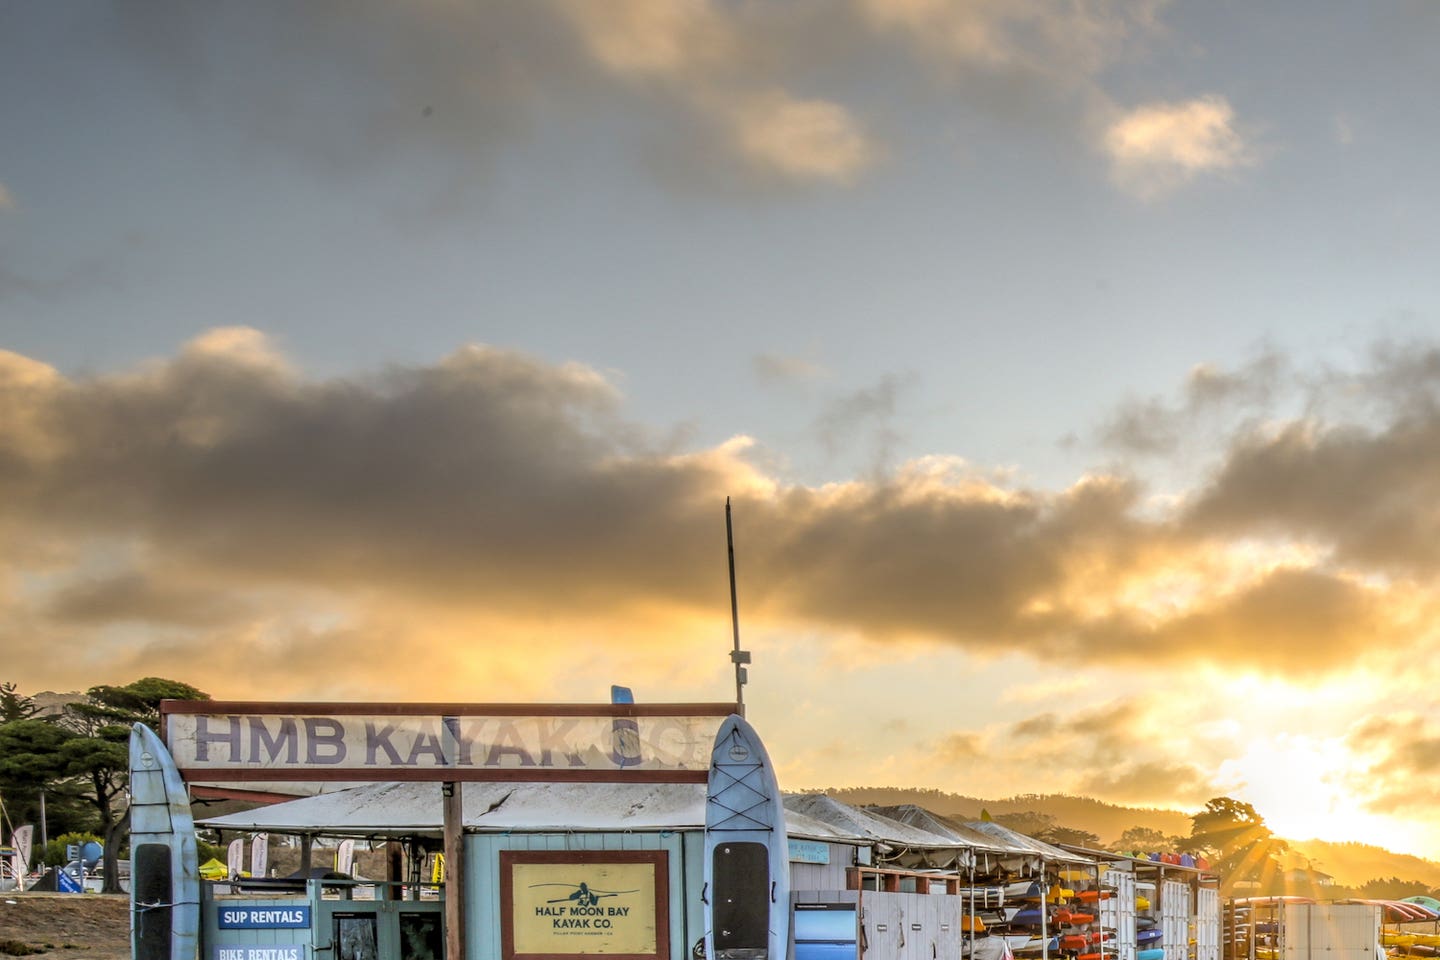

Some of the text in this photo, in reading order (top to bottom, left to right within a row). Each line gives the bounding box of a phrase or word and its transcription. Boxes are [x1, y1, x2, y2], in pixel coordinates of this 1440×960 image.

[194, 714, 347, 765] HMB
[364, 717, 587, 767] KAYAK
[224, 911, 303, 923] SUP RENTALS
[535, 907, 630, 916] HALF MOON BAY
[553, 919, 613, 928] KAYAK CO.
[219, 949, 298, 960] BIKE RENTALS
